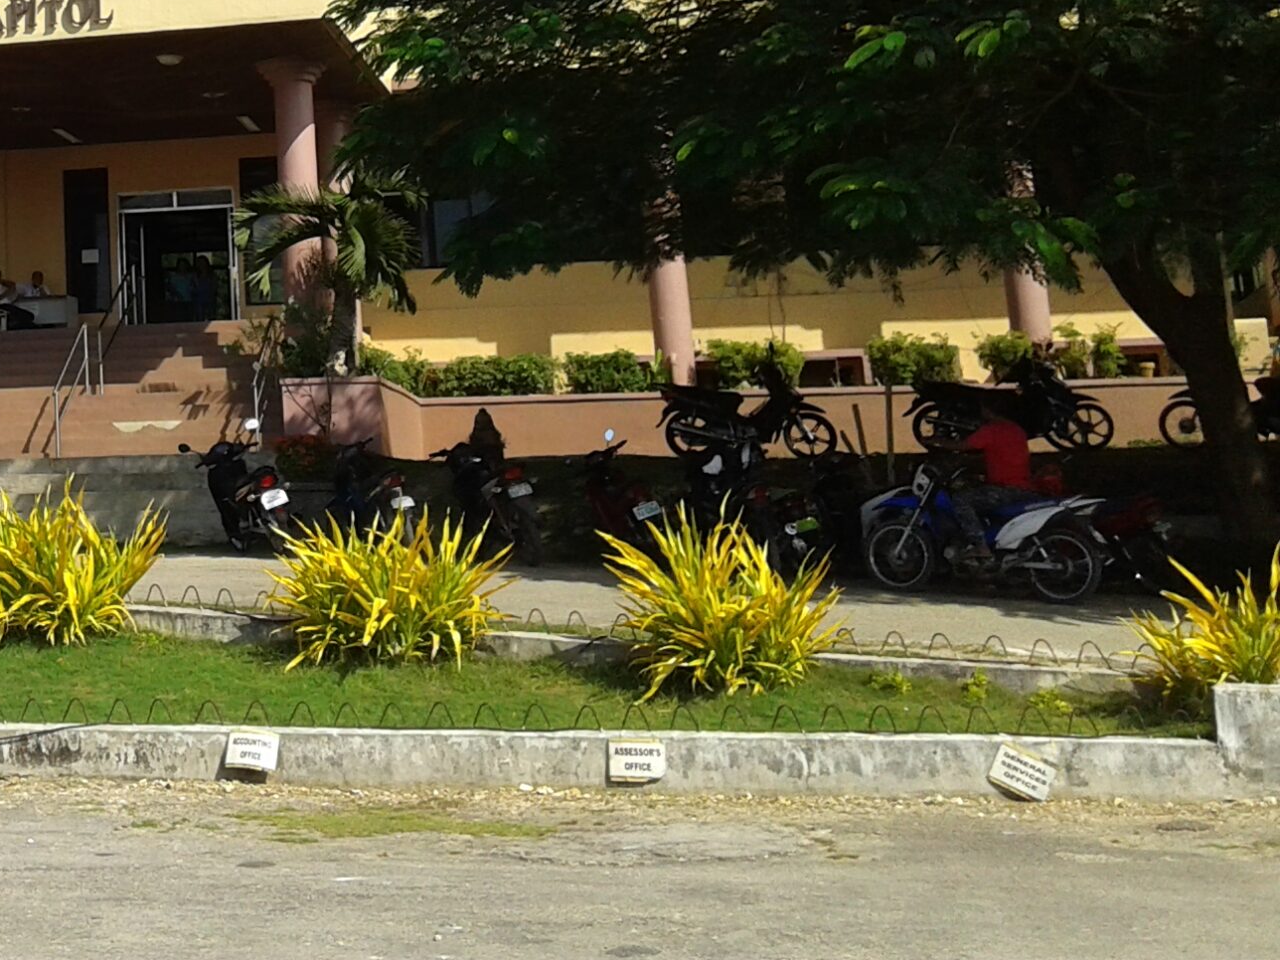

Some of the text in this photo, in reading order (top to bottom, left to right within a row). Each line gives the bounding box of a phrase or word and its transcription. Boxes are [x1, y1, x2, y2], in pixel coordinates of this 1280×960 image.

[240, 751, 261, 760] OFFICE
[614, 747, 661, 757] ASSESSOR'S
[624, 762, 651, 771] OFFICE
[1003, 751, 1047, 776] GENERAL
[1003, 771, 1038, 791] OFFICE
